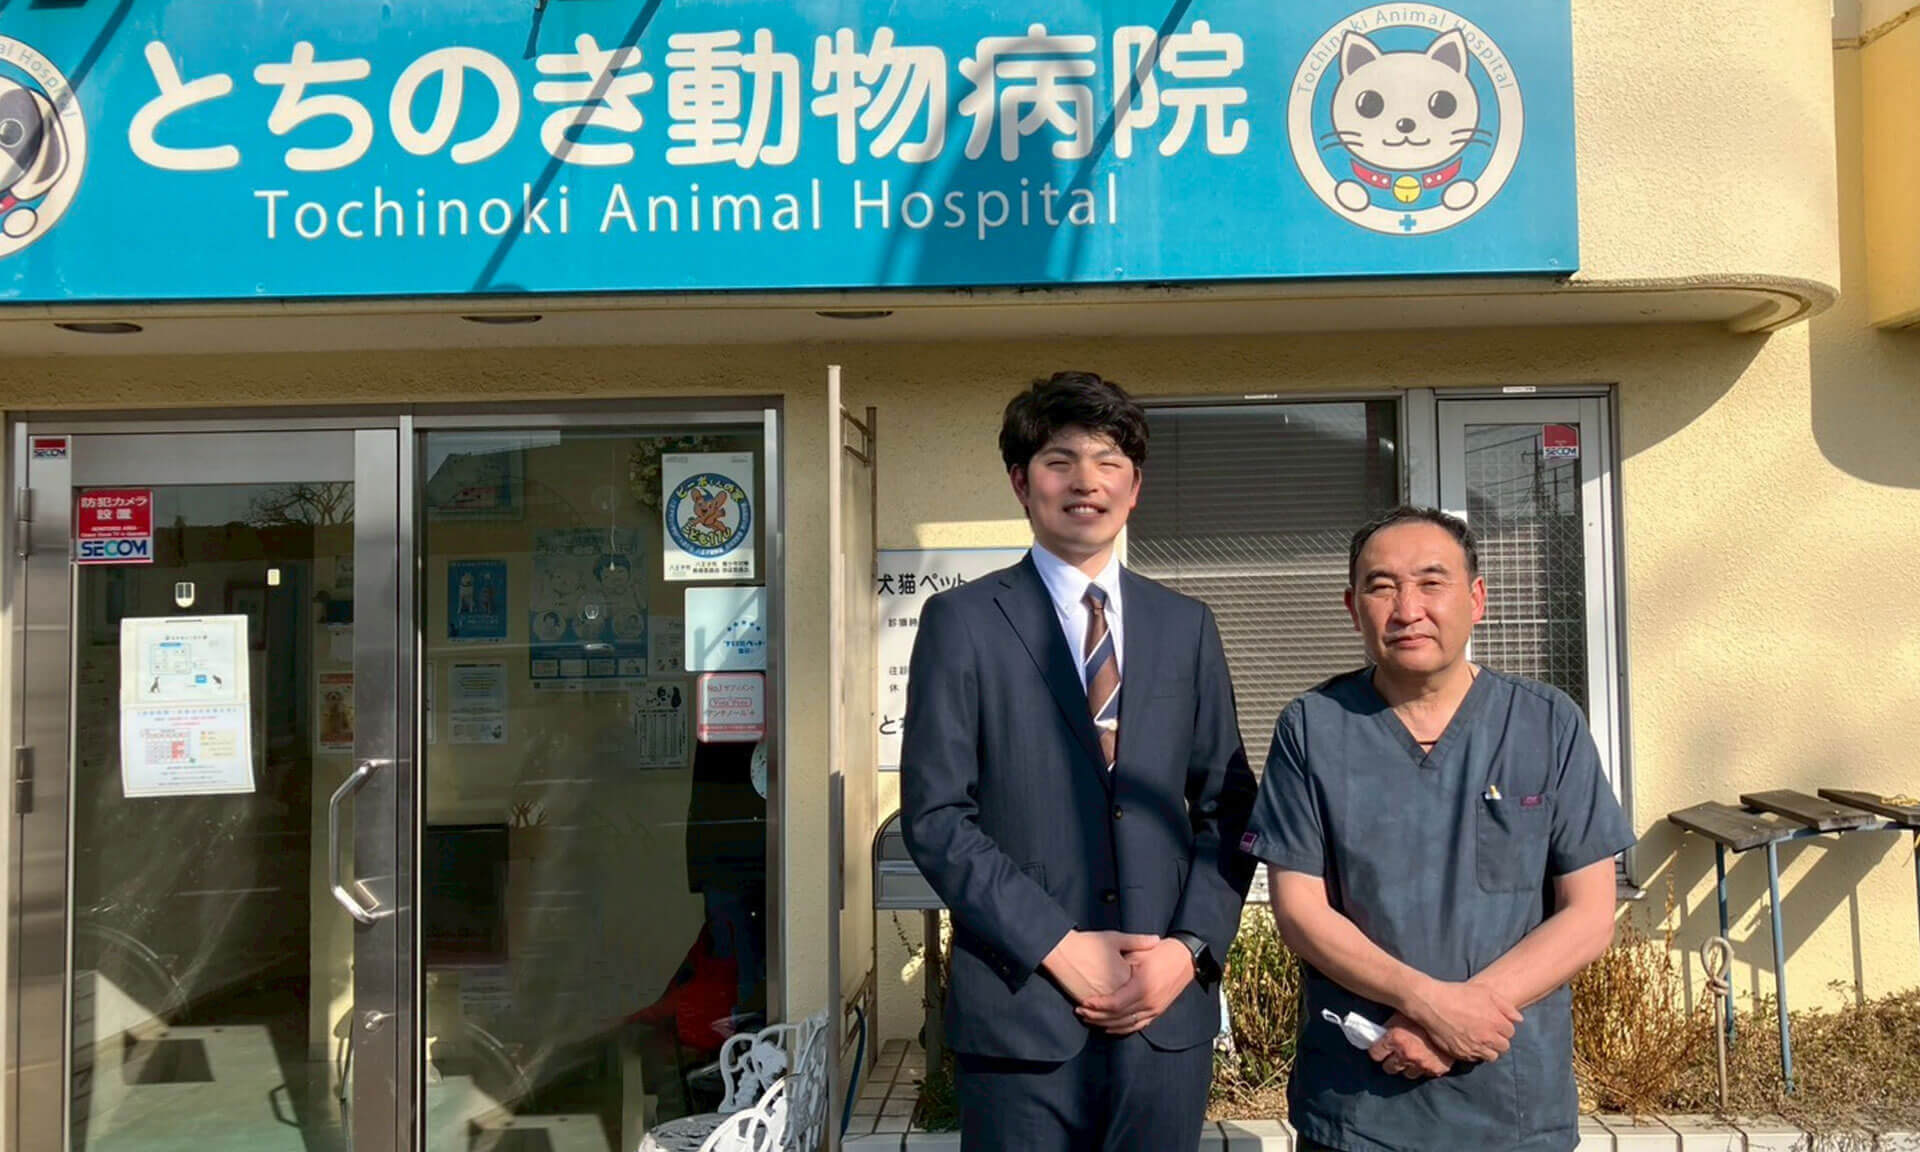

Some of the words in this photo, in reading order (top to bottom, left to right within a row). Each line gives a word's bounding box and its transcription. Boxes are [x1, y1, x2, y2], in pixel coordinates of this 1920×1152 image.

[1376, 9, 1446, 27] Animal
[128, 19, 1250, 171] とちのき動物病院
[254, 183, 569, 239] Tochinoki
[599, 177, 821, 233] Animal
[853, 172, 1117, 241] Hospital
[33, 448, 66, 457] SECOM
[1544, 447, 1577, 457] SECOM
[80, 495, 149, 509] 防犯カメラ
[81, 540, 148, 558] SECOM
[879, 714, 905, 735] と
